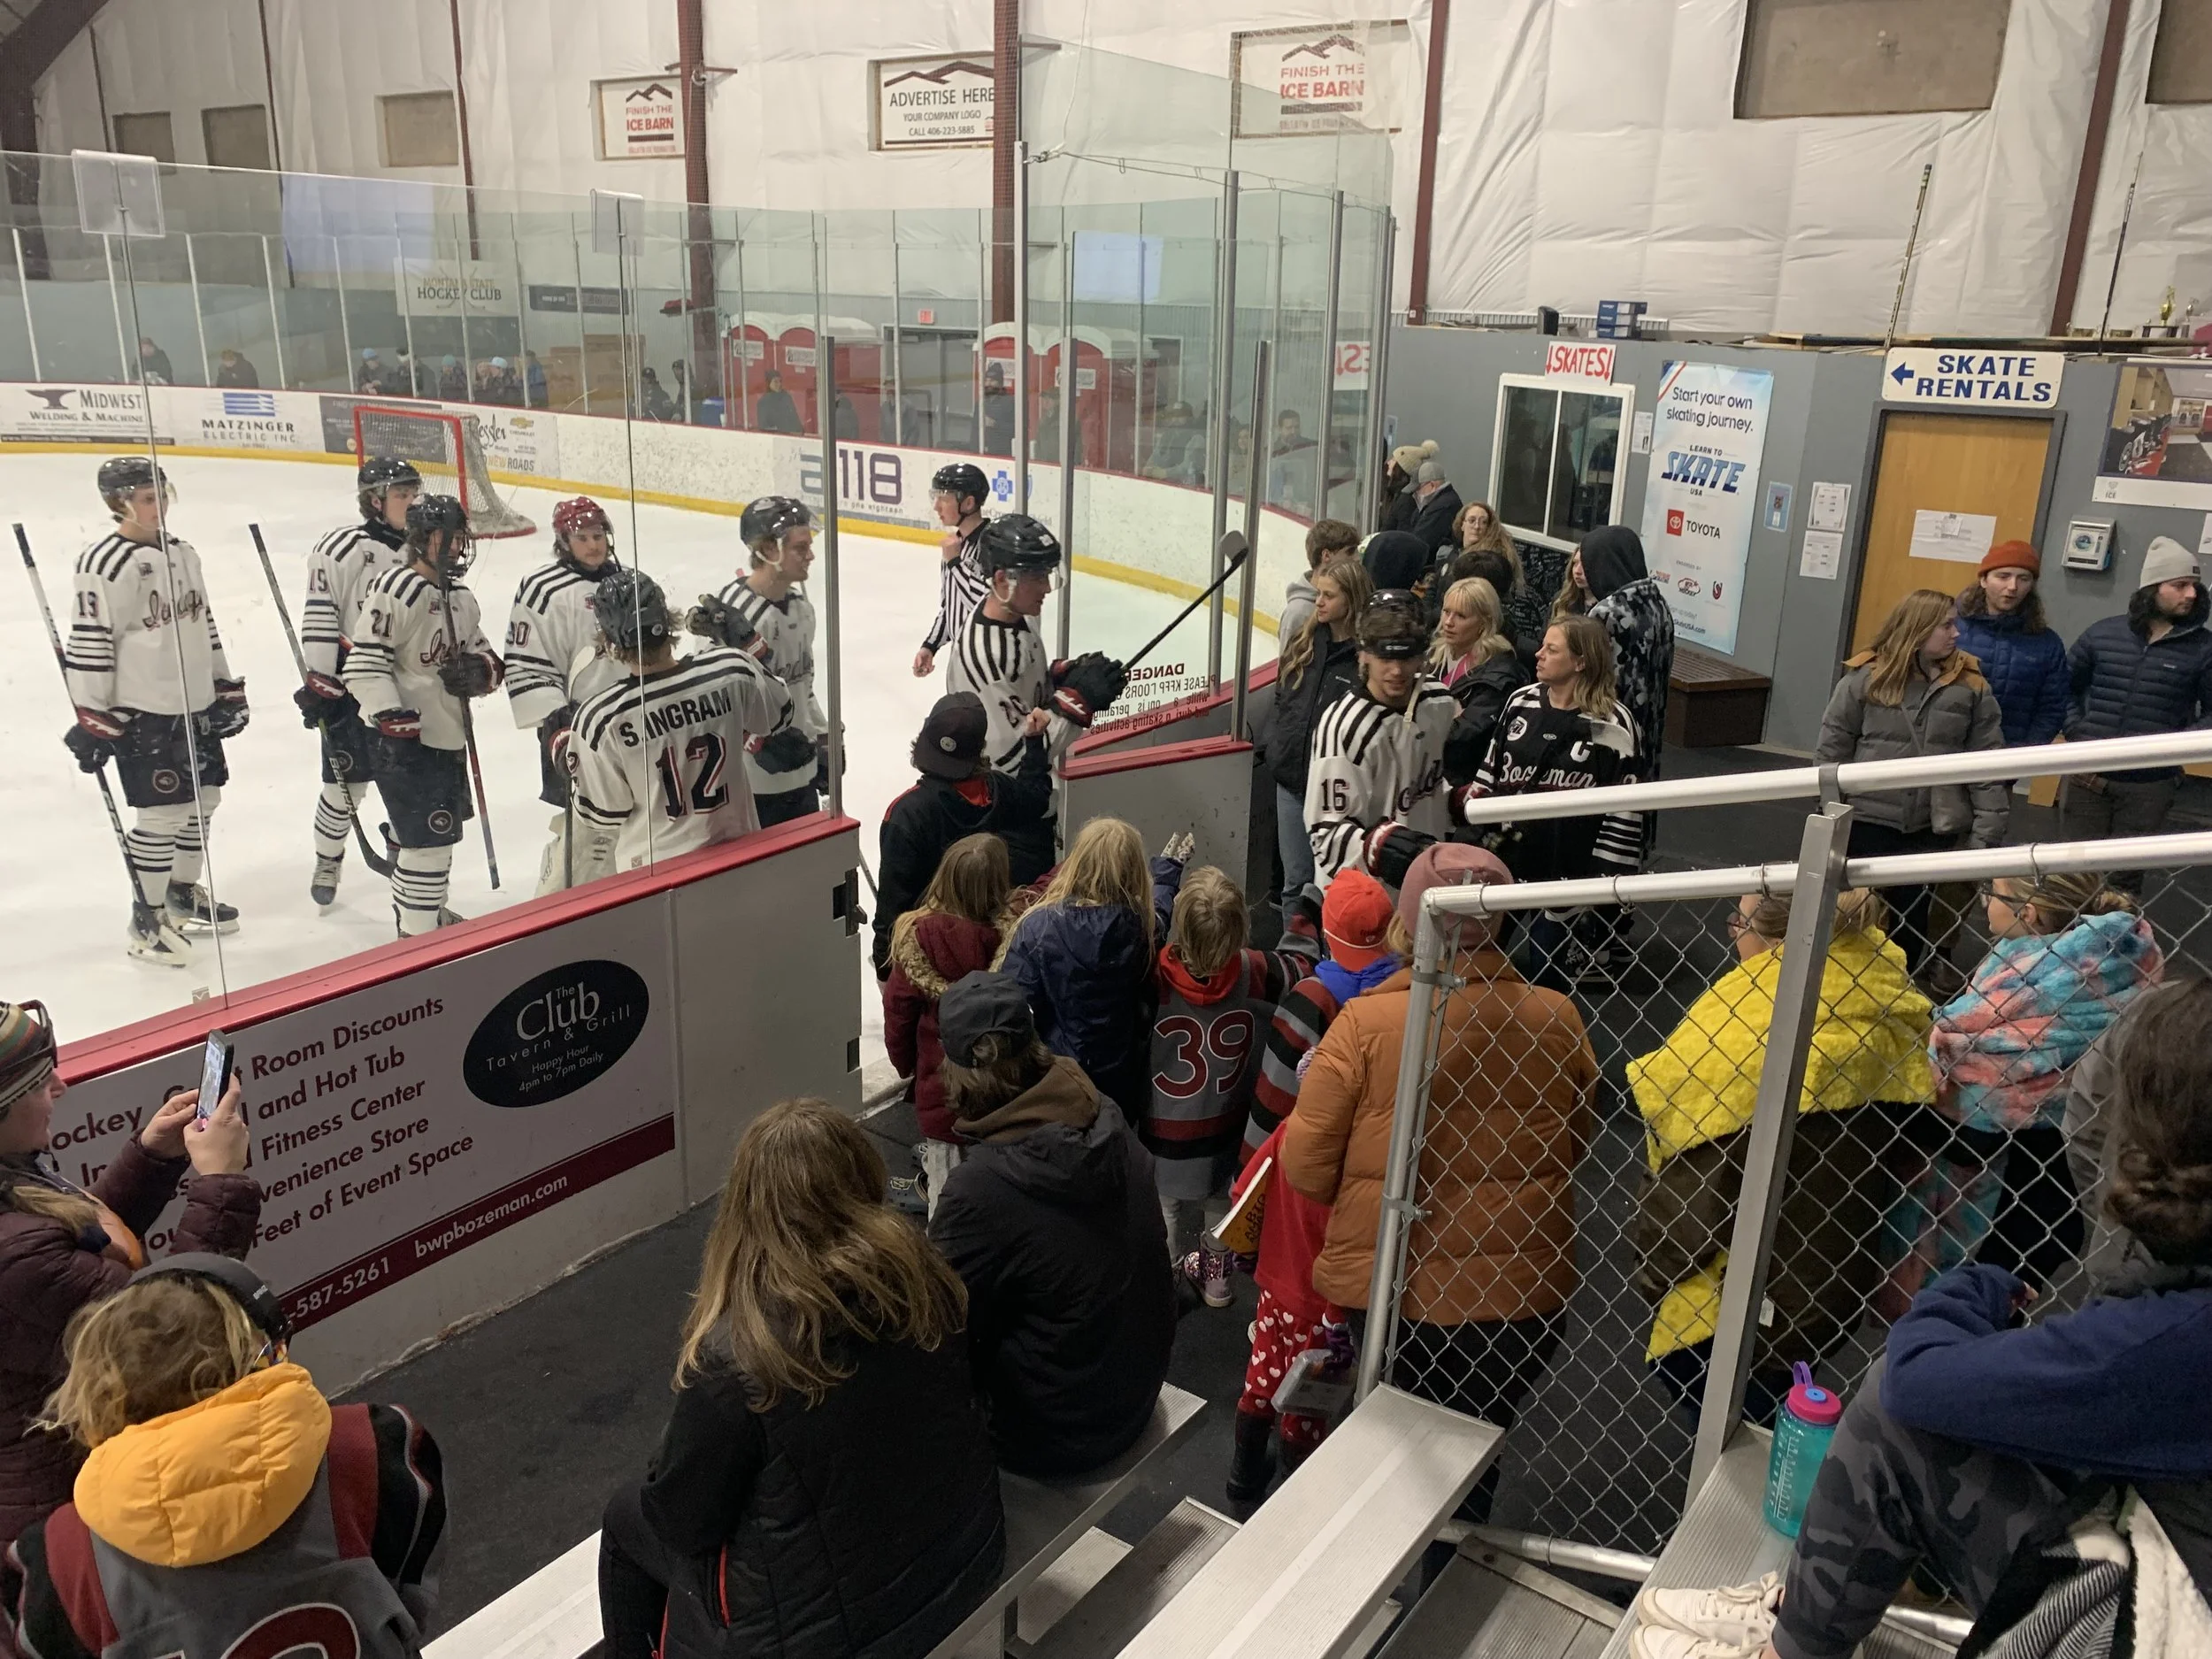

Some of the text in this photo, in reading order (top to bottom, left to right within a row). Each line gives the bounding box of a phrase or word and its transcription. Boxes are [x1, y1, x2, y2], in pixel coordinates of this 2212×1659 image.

[1280, 63, 1365, 79] FINISH THE
[889, 87, 995, 107] ADVERTISE HERE
[1280, 80, 1364, 99] ICE BARN
[626, 104, 673, 115] FINISH THE
[902, 109, 981, 121] YOUR COMPANY LOGO
[626, 117, 674, 132] ICE BARN
[909, 127, 926, 136] CALL
[470, 288, 502, 300] CLUB
[1937, 354, 2037, 377] SKATE
[80, 389, 142, 411] MIDWEST
[1672, 386, 1753, 410] Start your own
[1916, 377, 2053, 402] RENTALS
[29, 411, 144, 423] WELDING & MACHINE
[201, 419, 295, 433] MATZINGER
[1666, 407, 1754, 434] skating journey.
[203, 431, 267, 442] ELECTRIC
[1689, 444, 1723, 457] LEARN TO
[507, 457, 534, 472] ROADS
[1661, 450, 1747, 494] SKATE
[1689, 488, 1703, 497] USA
[1686, 520, 1721, 539] TOYOTA
[310, 568, 331, 595] 15
[370, 608, 394, 640] 21
[1570, 740, 1594, 764] C
[655, 730, 731, 823] 12
[1321, 778, 1350, 814] 16
[555, 985, 575, 1000] The
[516, 980, 601, 1041] Club
[486, 1004, 631, 1071] Tavern & Grill
[531, 1044, 590, 1073] Happy Hour
[1152, 1009, 1256, 1099] 39
[50, 997, 445, 1150] ockey Room Discounts
[257, 1079, 308, 1120] and
[315, 1064, 358, 1098] Hot
[364, 1044, 405, 1078] Tub
[518, 1051, 604, 1094] 4pm to 7pm Daily
[261, 1079, 426, 1162] Fitness Center
[261, 1117, 430, 1203] venience Store
[251, 1135, 474, 1250] Feet of Event Space
[287, 1172, 569, 1319] -587-5261 bwpbozeman.com
